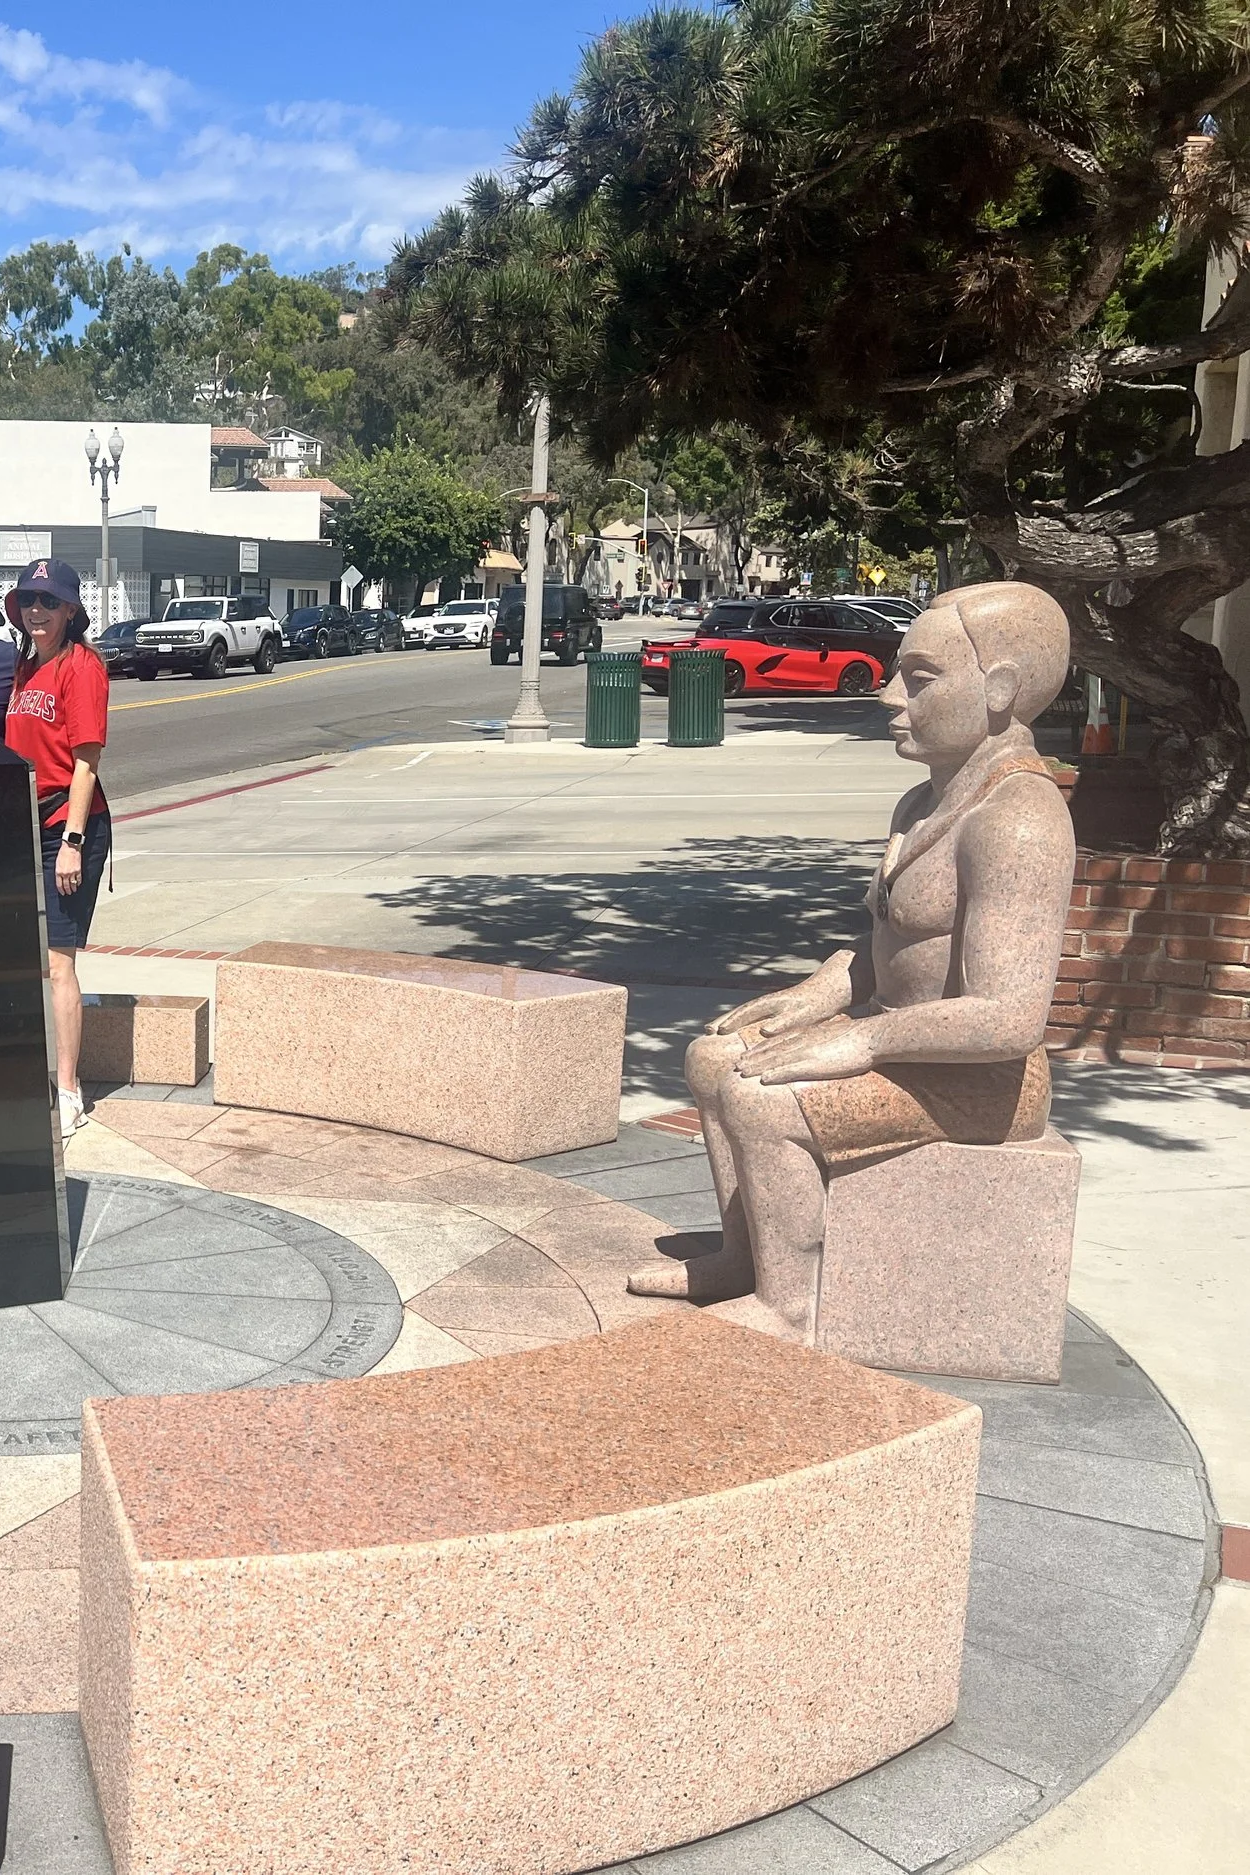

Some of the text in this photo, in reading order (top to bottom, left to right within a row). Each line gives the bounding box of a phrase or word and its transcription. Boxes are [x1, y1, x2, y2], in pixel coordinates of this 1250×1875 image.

[32, 562, 48, 578] A
[90, 1178, 178, 1196] SUCCES
[320, 1311, 381, 1368] STRENGTH
